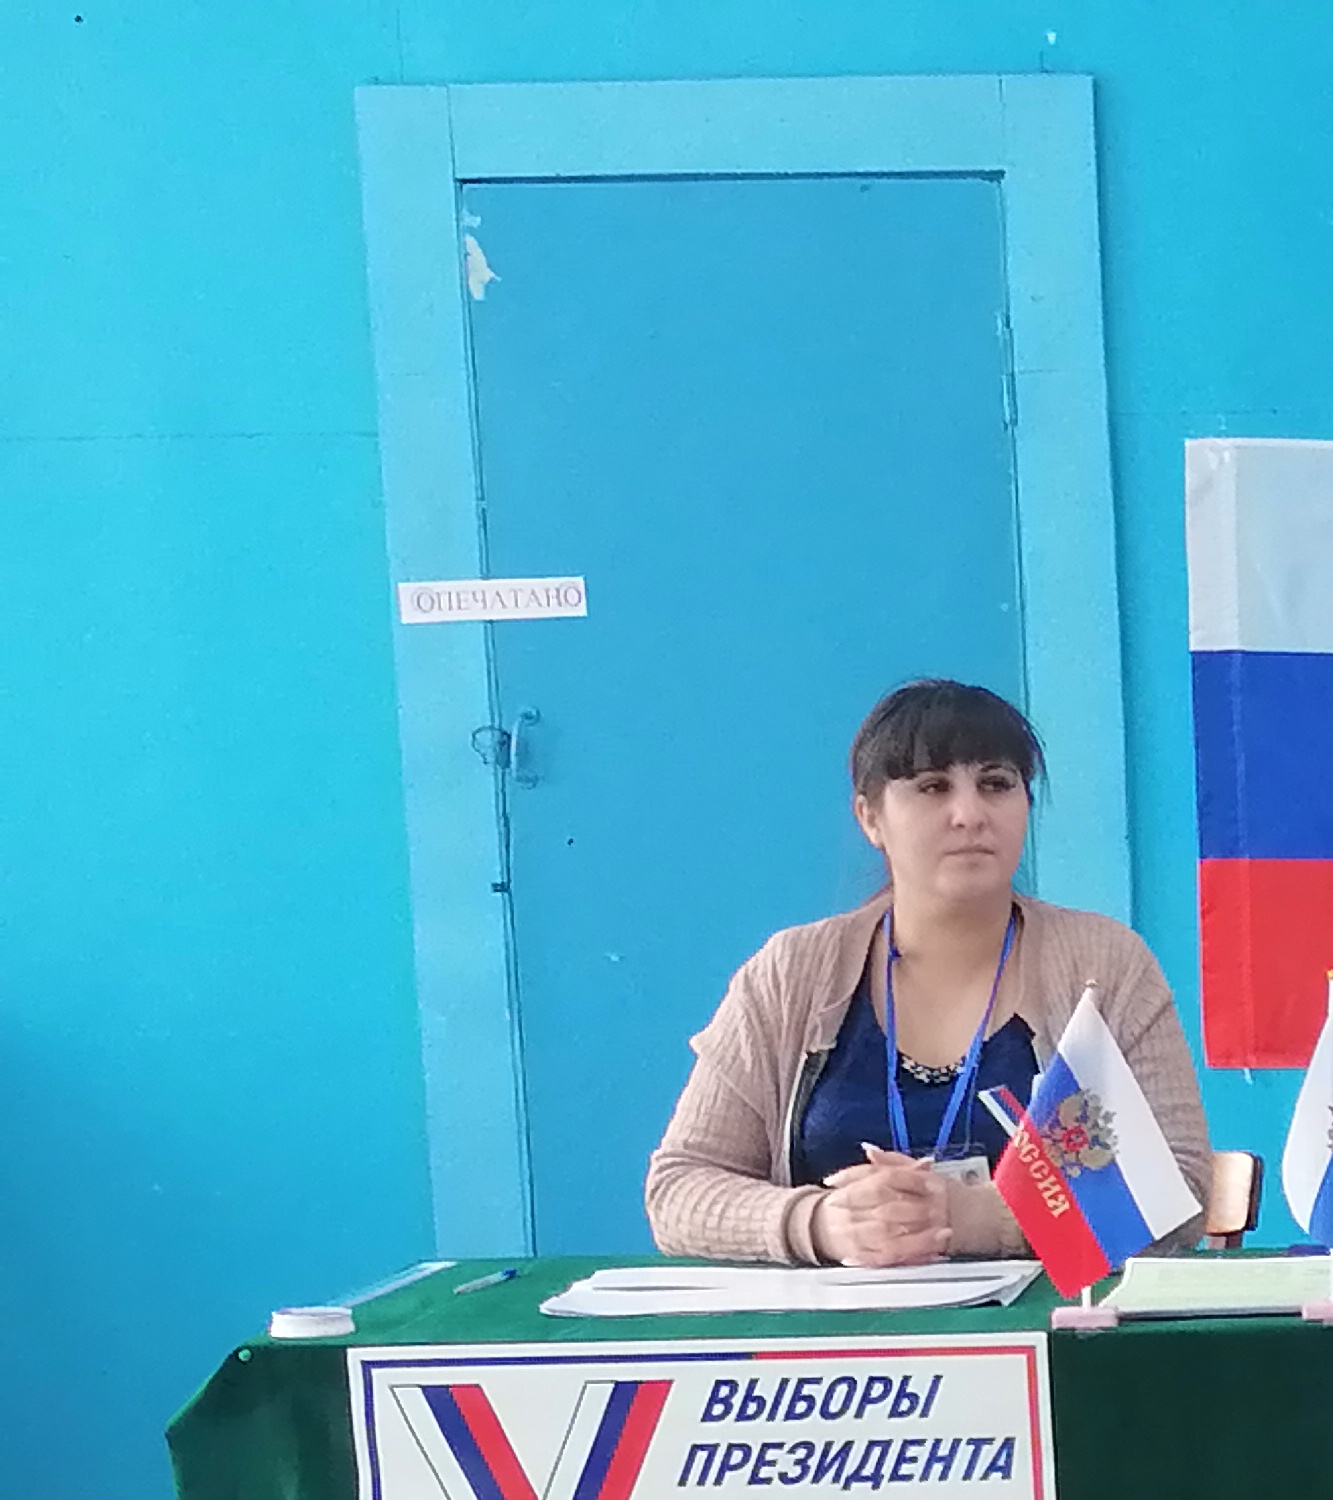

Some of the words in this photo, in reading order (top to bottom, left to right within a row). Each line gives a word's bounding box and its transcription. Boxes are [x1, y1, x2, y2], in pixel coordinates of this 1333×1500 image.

[416, 586, 582, 614] ОПЕЧАТАНО
[699, 1374, 943, 1424] ВЫБОРЫ
[676, 1435, 1017, 1491] ПРЕЗИДЕНТА
